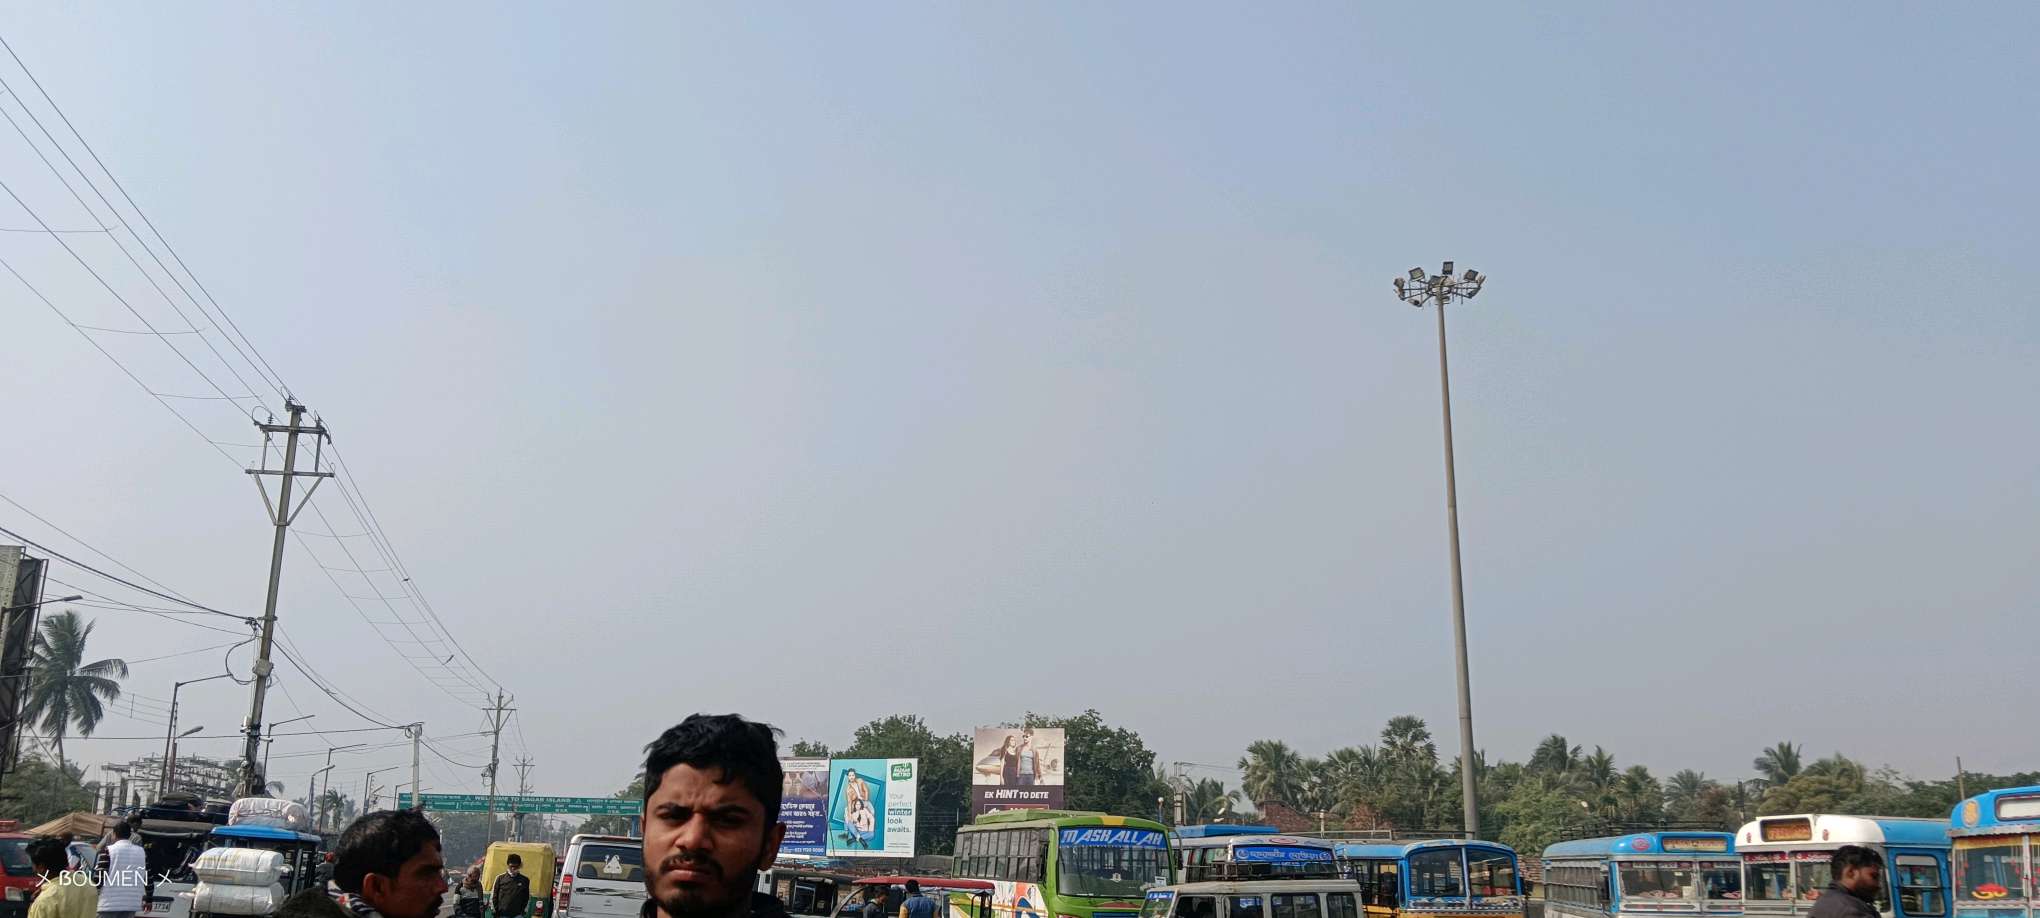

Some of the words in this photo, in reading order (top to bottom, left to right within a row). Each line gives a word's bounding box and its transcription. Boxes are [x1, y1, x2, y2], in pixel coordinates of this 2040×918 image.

[995, 789, 1019, 799] HINT
[1019, 791, 1029, 799] TO
[1030, 791, 1049, 799] DETE
[887, 825, 912, 833] awaits.
